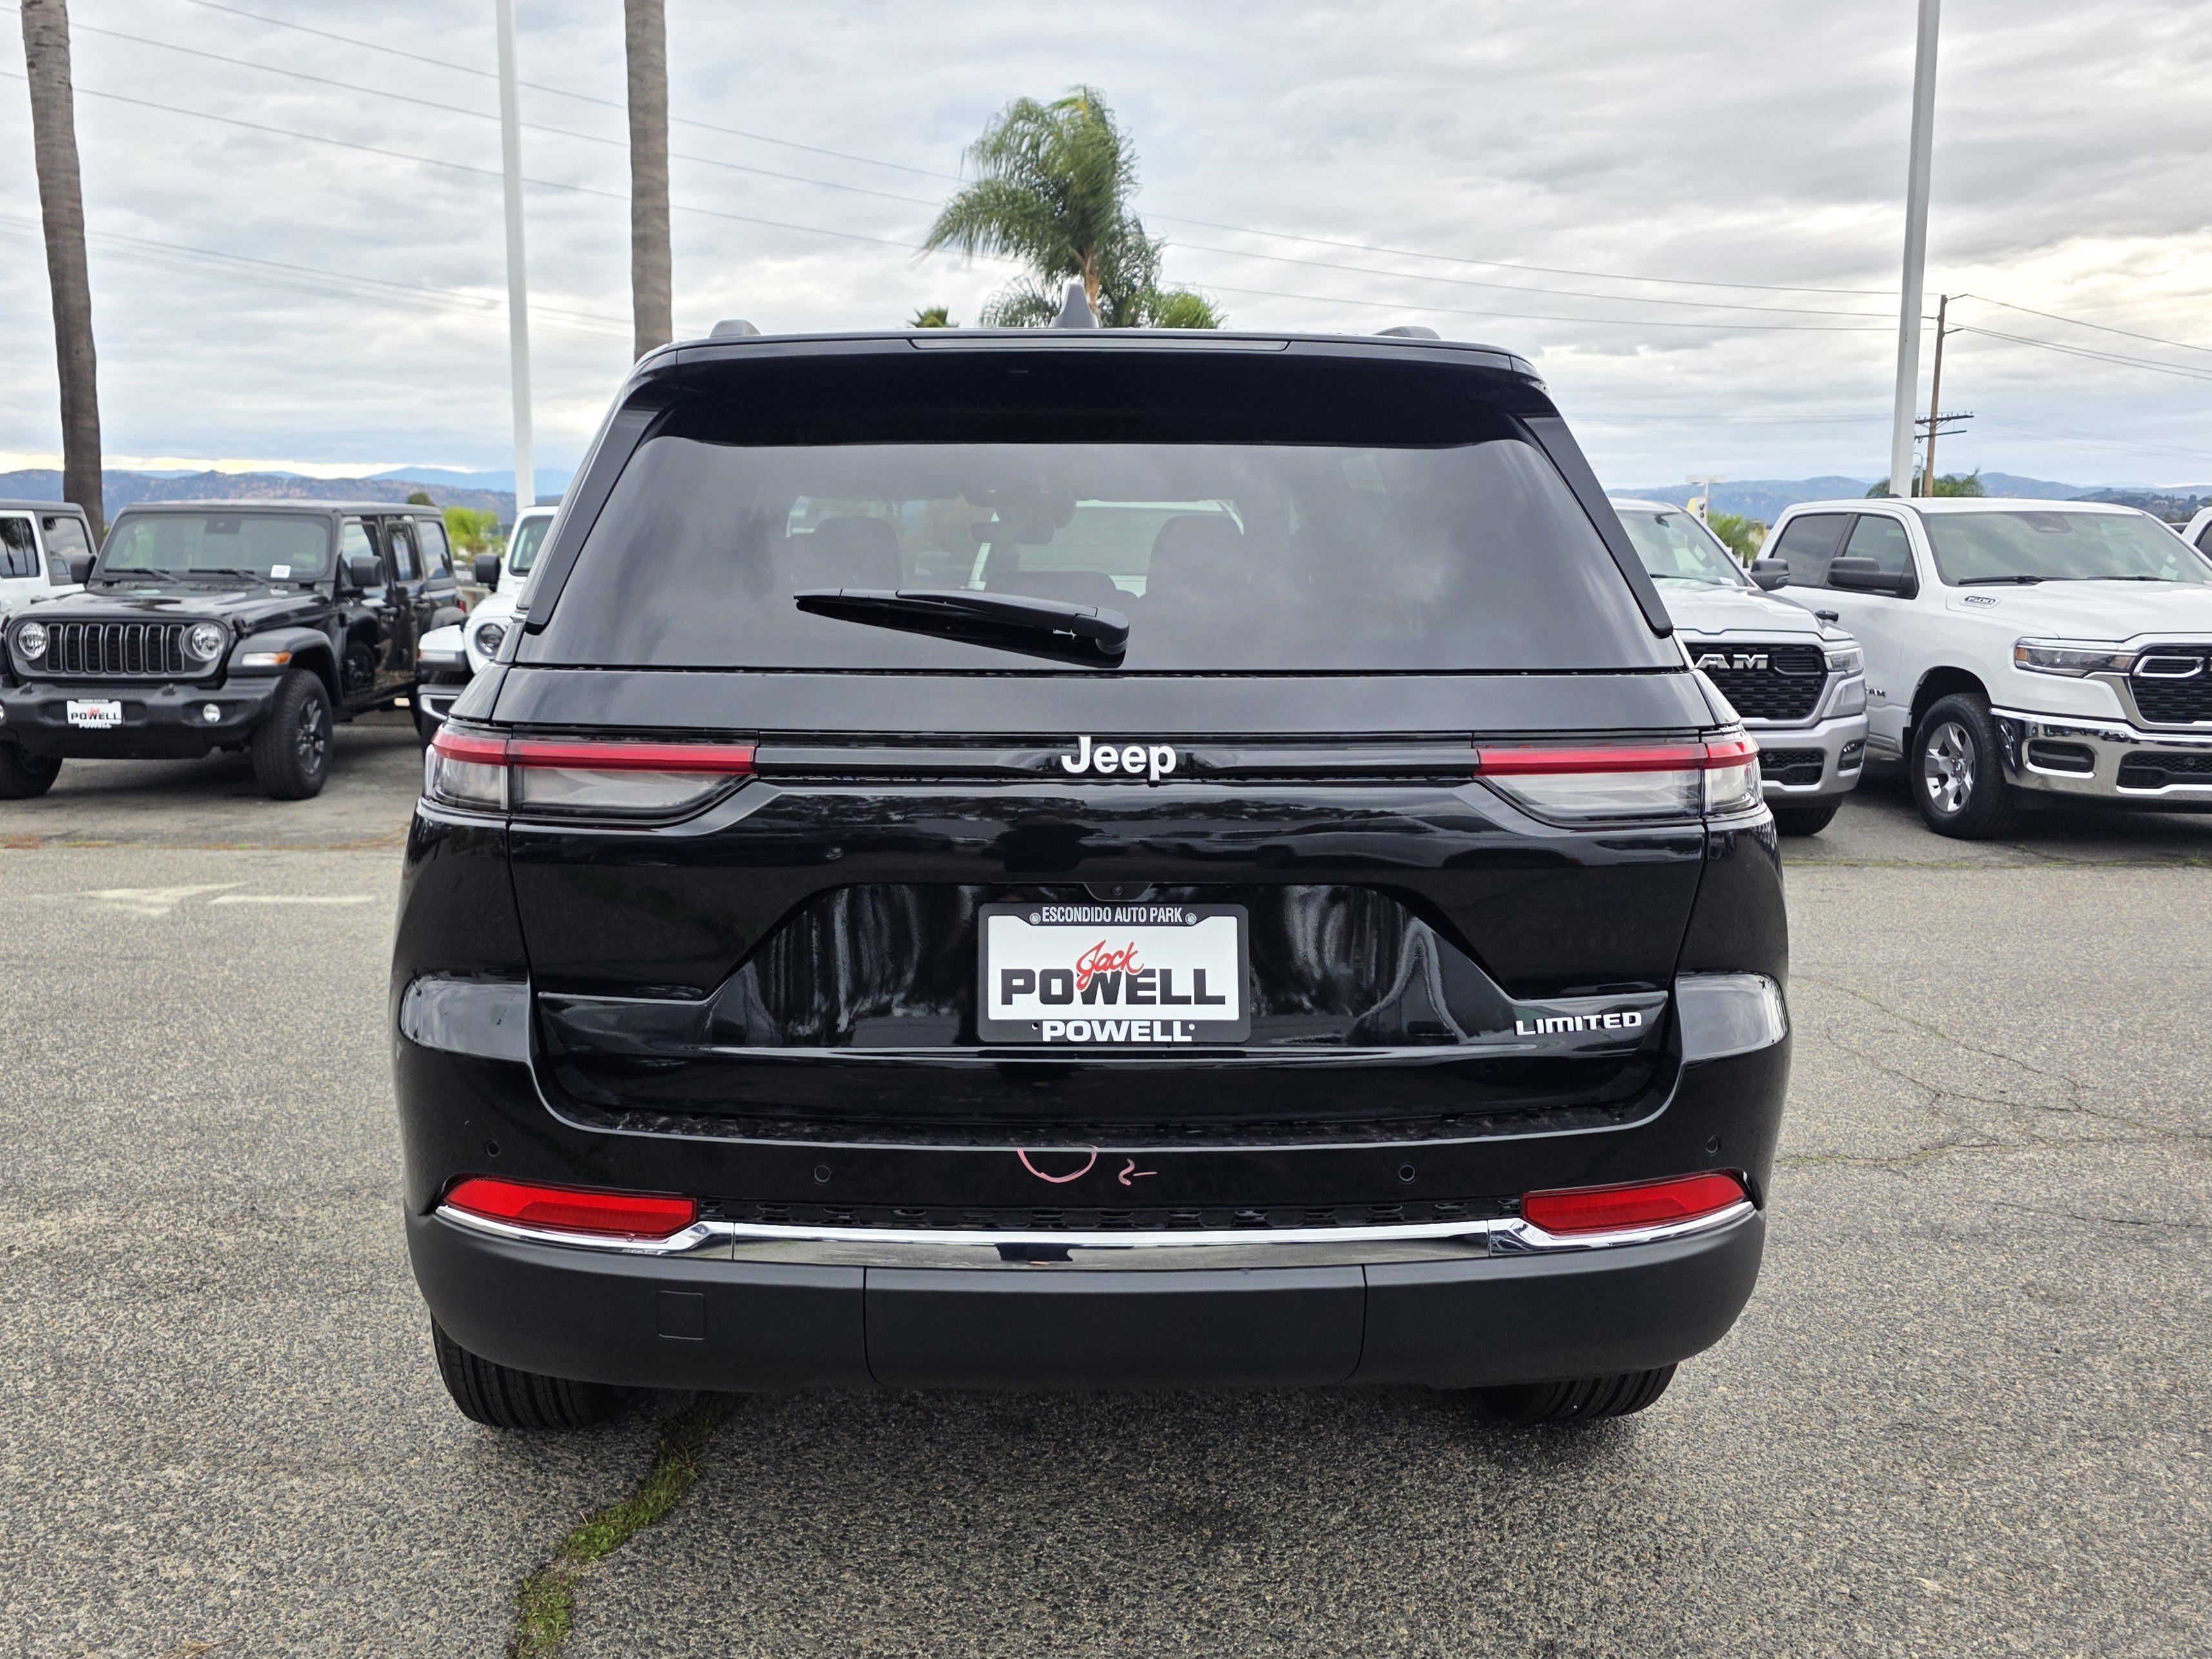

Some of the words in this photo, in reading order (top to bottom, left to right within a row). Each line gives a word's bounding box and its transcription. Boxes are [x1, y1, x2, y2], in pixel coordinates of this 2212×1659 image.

[1694, 654, 1768, 669] AM
[1061, 736, 1177, 781] Jeep
[1042, 907, 1111, 923] ESCONDIDO
[1114, 907, 1147, 923] AUTO
[1150, 907, 1182, 923] PARK
[1075, 939, 1144, 992] Jack
[1001, 968, 1226, 1005] POWELL
[1042, 1020, 1192, 1042] POWELL
[1515, 1012, 1642, 1036] LIMITED
